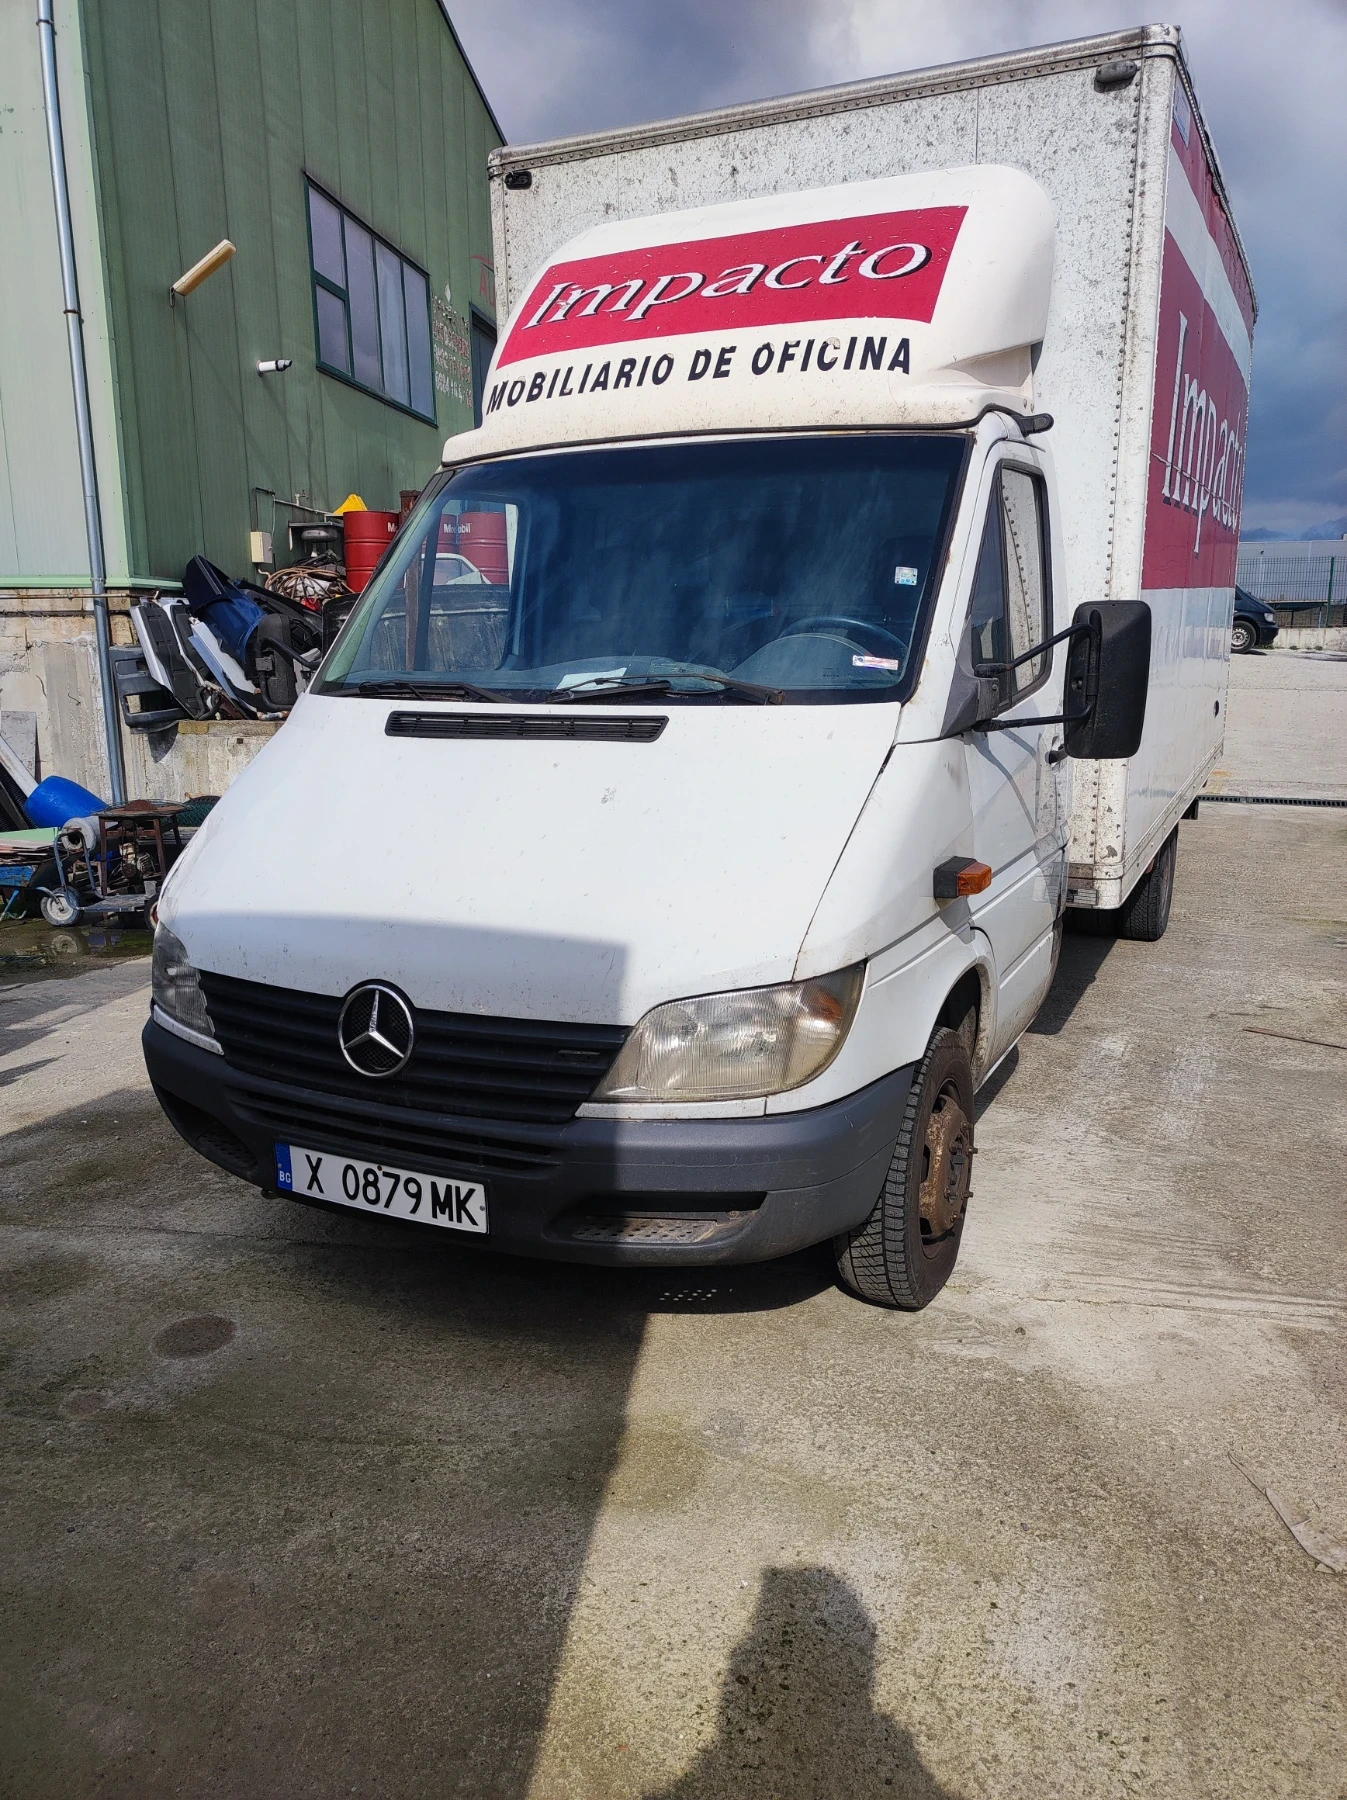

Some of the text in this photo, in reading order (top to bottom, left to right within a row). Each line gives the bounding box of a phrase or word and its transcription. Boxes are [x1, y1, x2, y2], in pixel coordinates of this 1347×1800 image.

[521, 239, 933, 329] Impacto
[486, 352, 675, 416] MOBILIARIO
[688, 343, 736, 382] DE
[751, 335, 911, 376] OFICINA
[279, 1171, 291, 1183] BG
[305, 1154, 479, 1226] X 0879 MK
